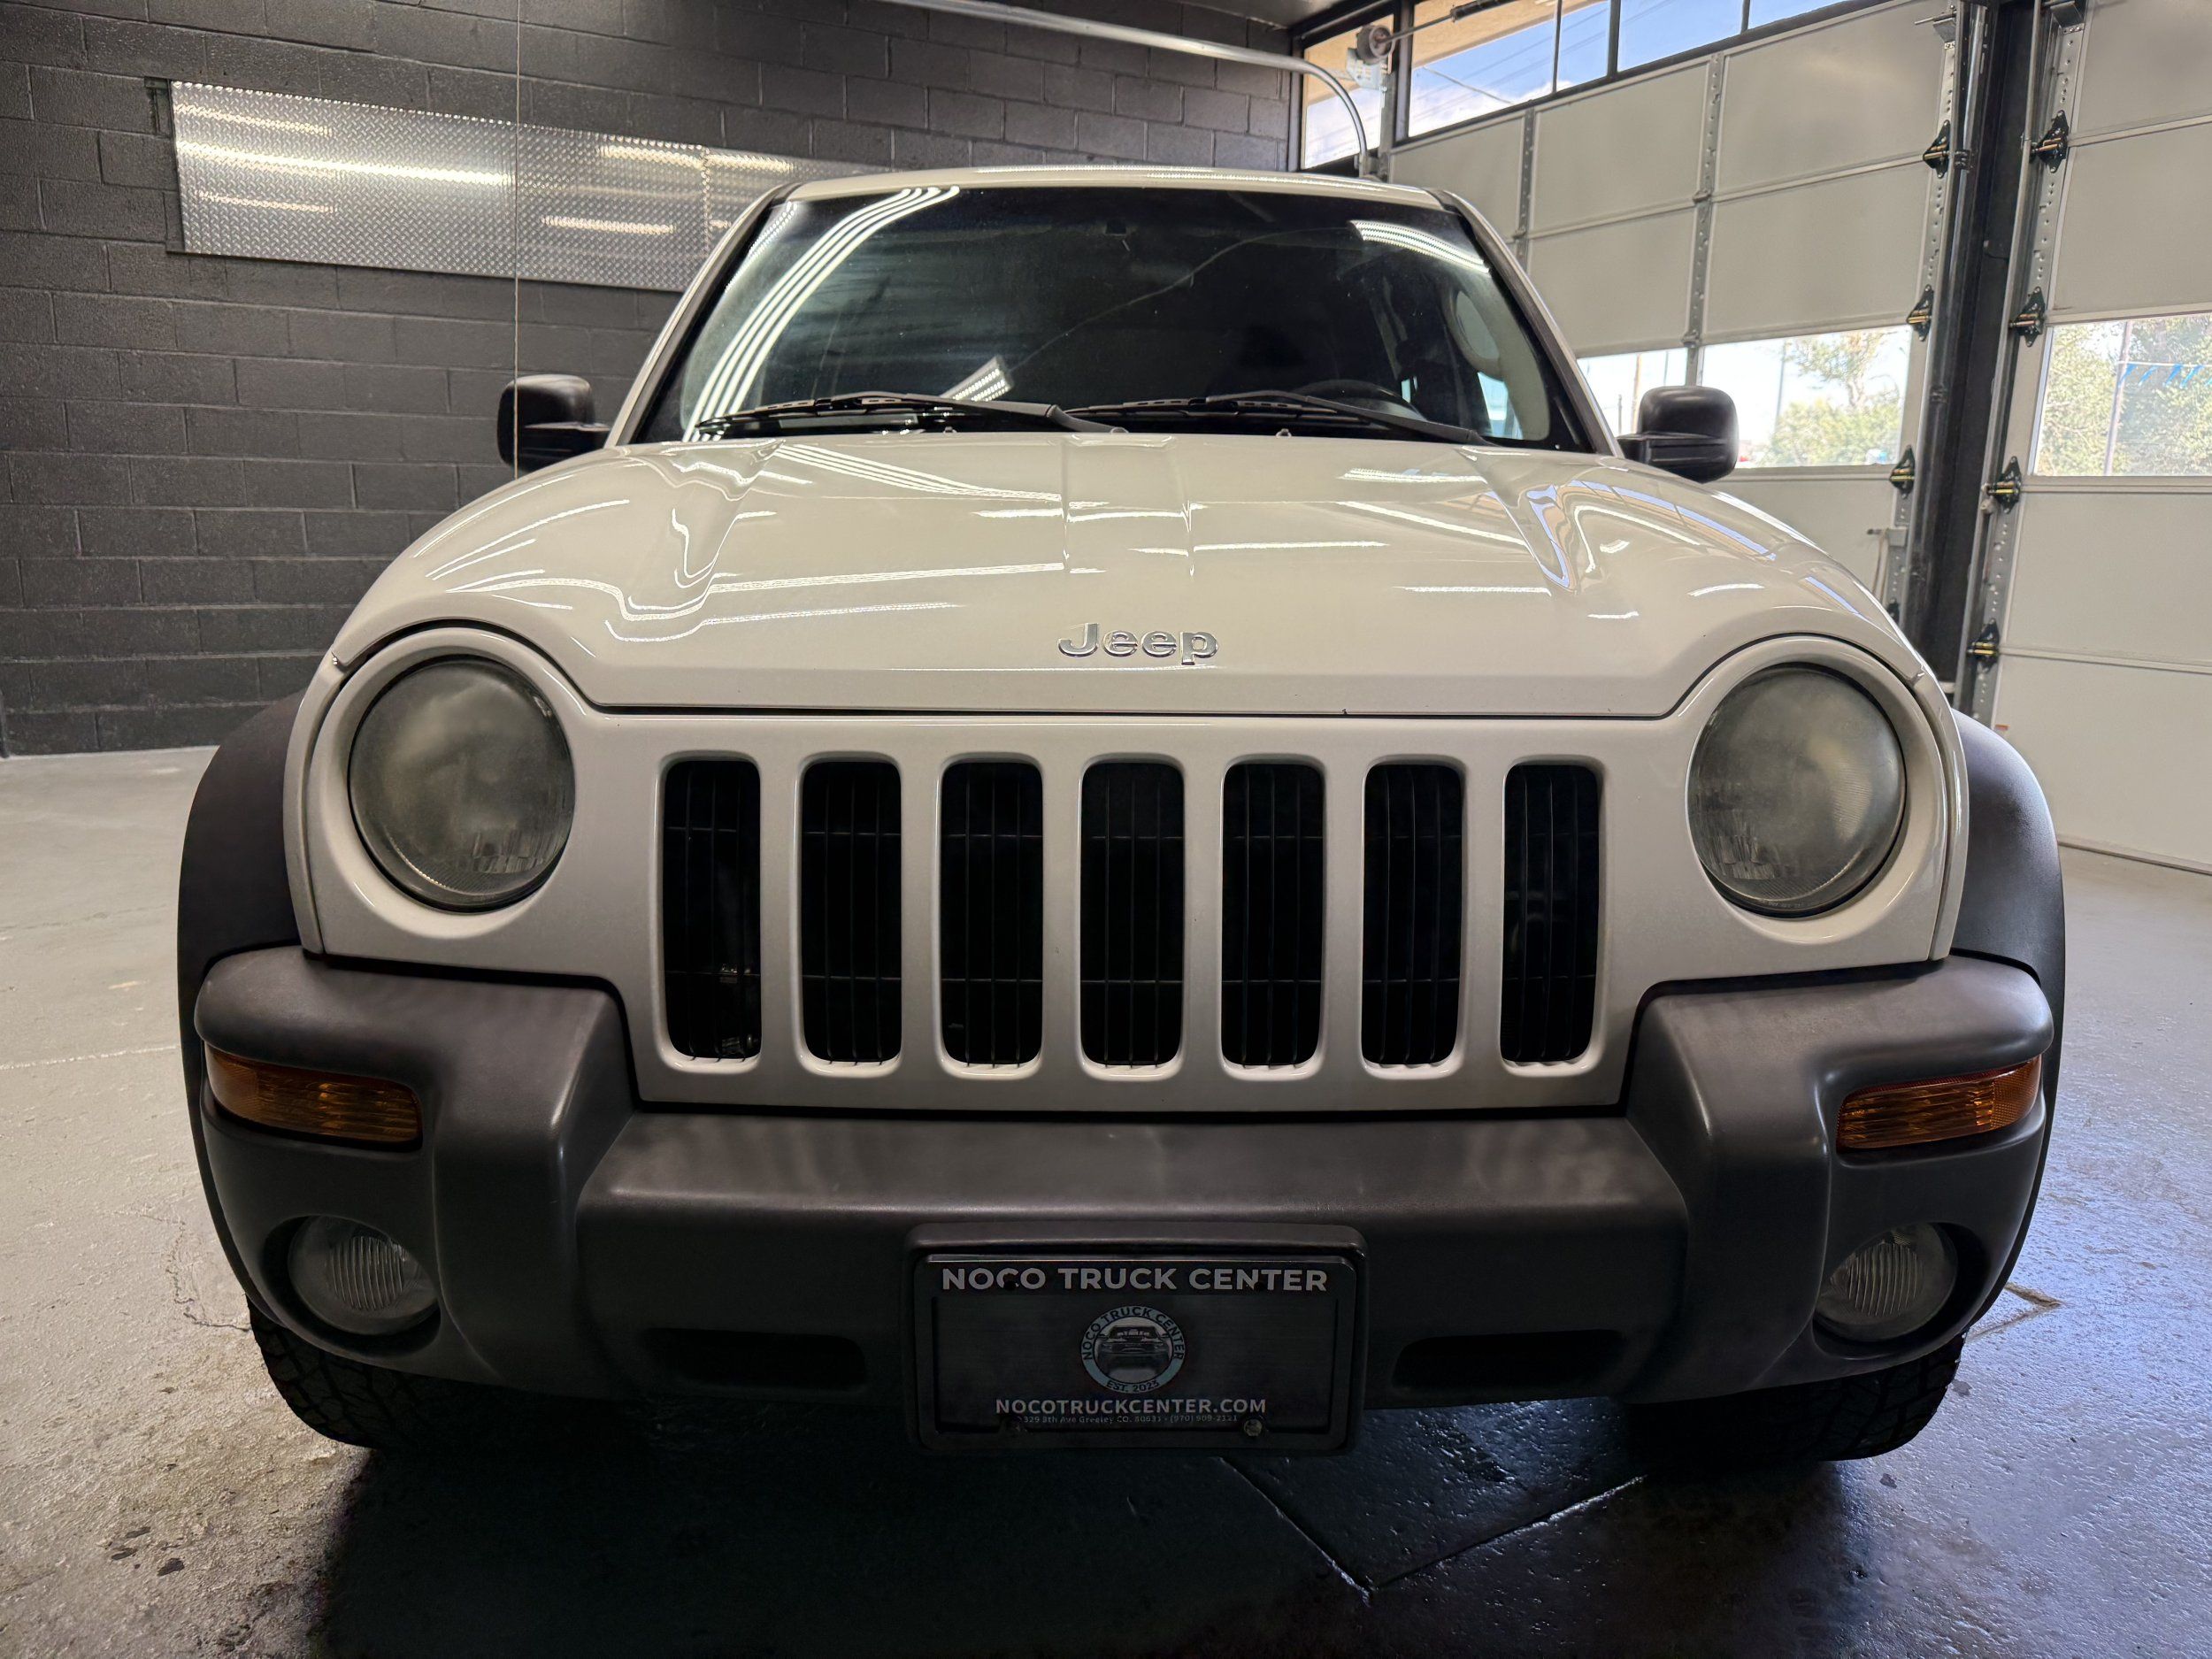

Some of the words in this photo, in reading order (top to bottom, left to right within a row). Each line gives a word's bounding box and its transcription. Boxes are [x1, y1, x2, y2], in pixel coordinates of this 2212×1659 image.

[1058, 622, 1218, 665] Jeep
[942, 1268, 1046, 1290] NOCO
[1058, 1268, 1178, 1290] TRUCK
[1189, 1268, 1328, 1292] CENTER
[1082, 1323, 1101, 1361] NOCO
[1101, 1307, 1152, 1324] TRUCK
[1156, 1314, 1185, 1360] CENTER
[1133, 1380, 1160, 1393] 2023
[995, 1398, 1267, 1415] NOCOTRUCKCENTER.COM
